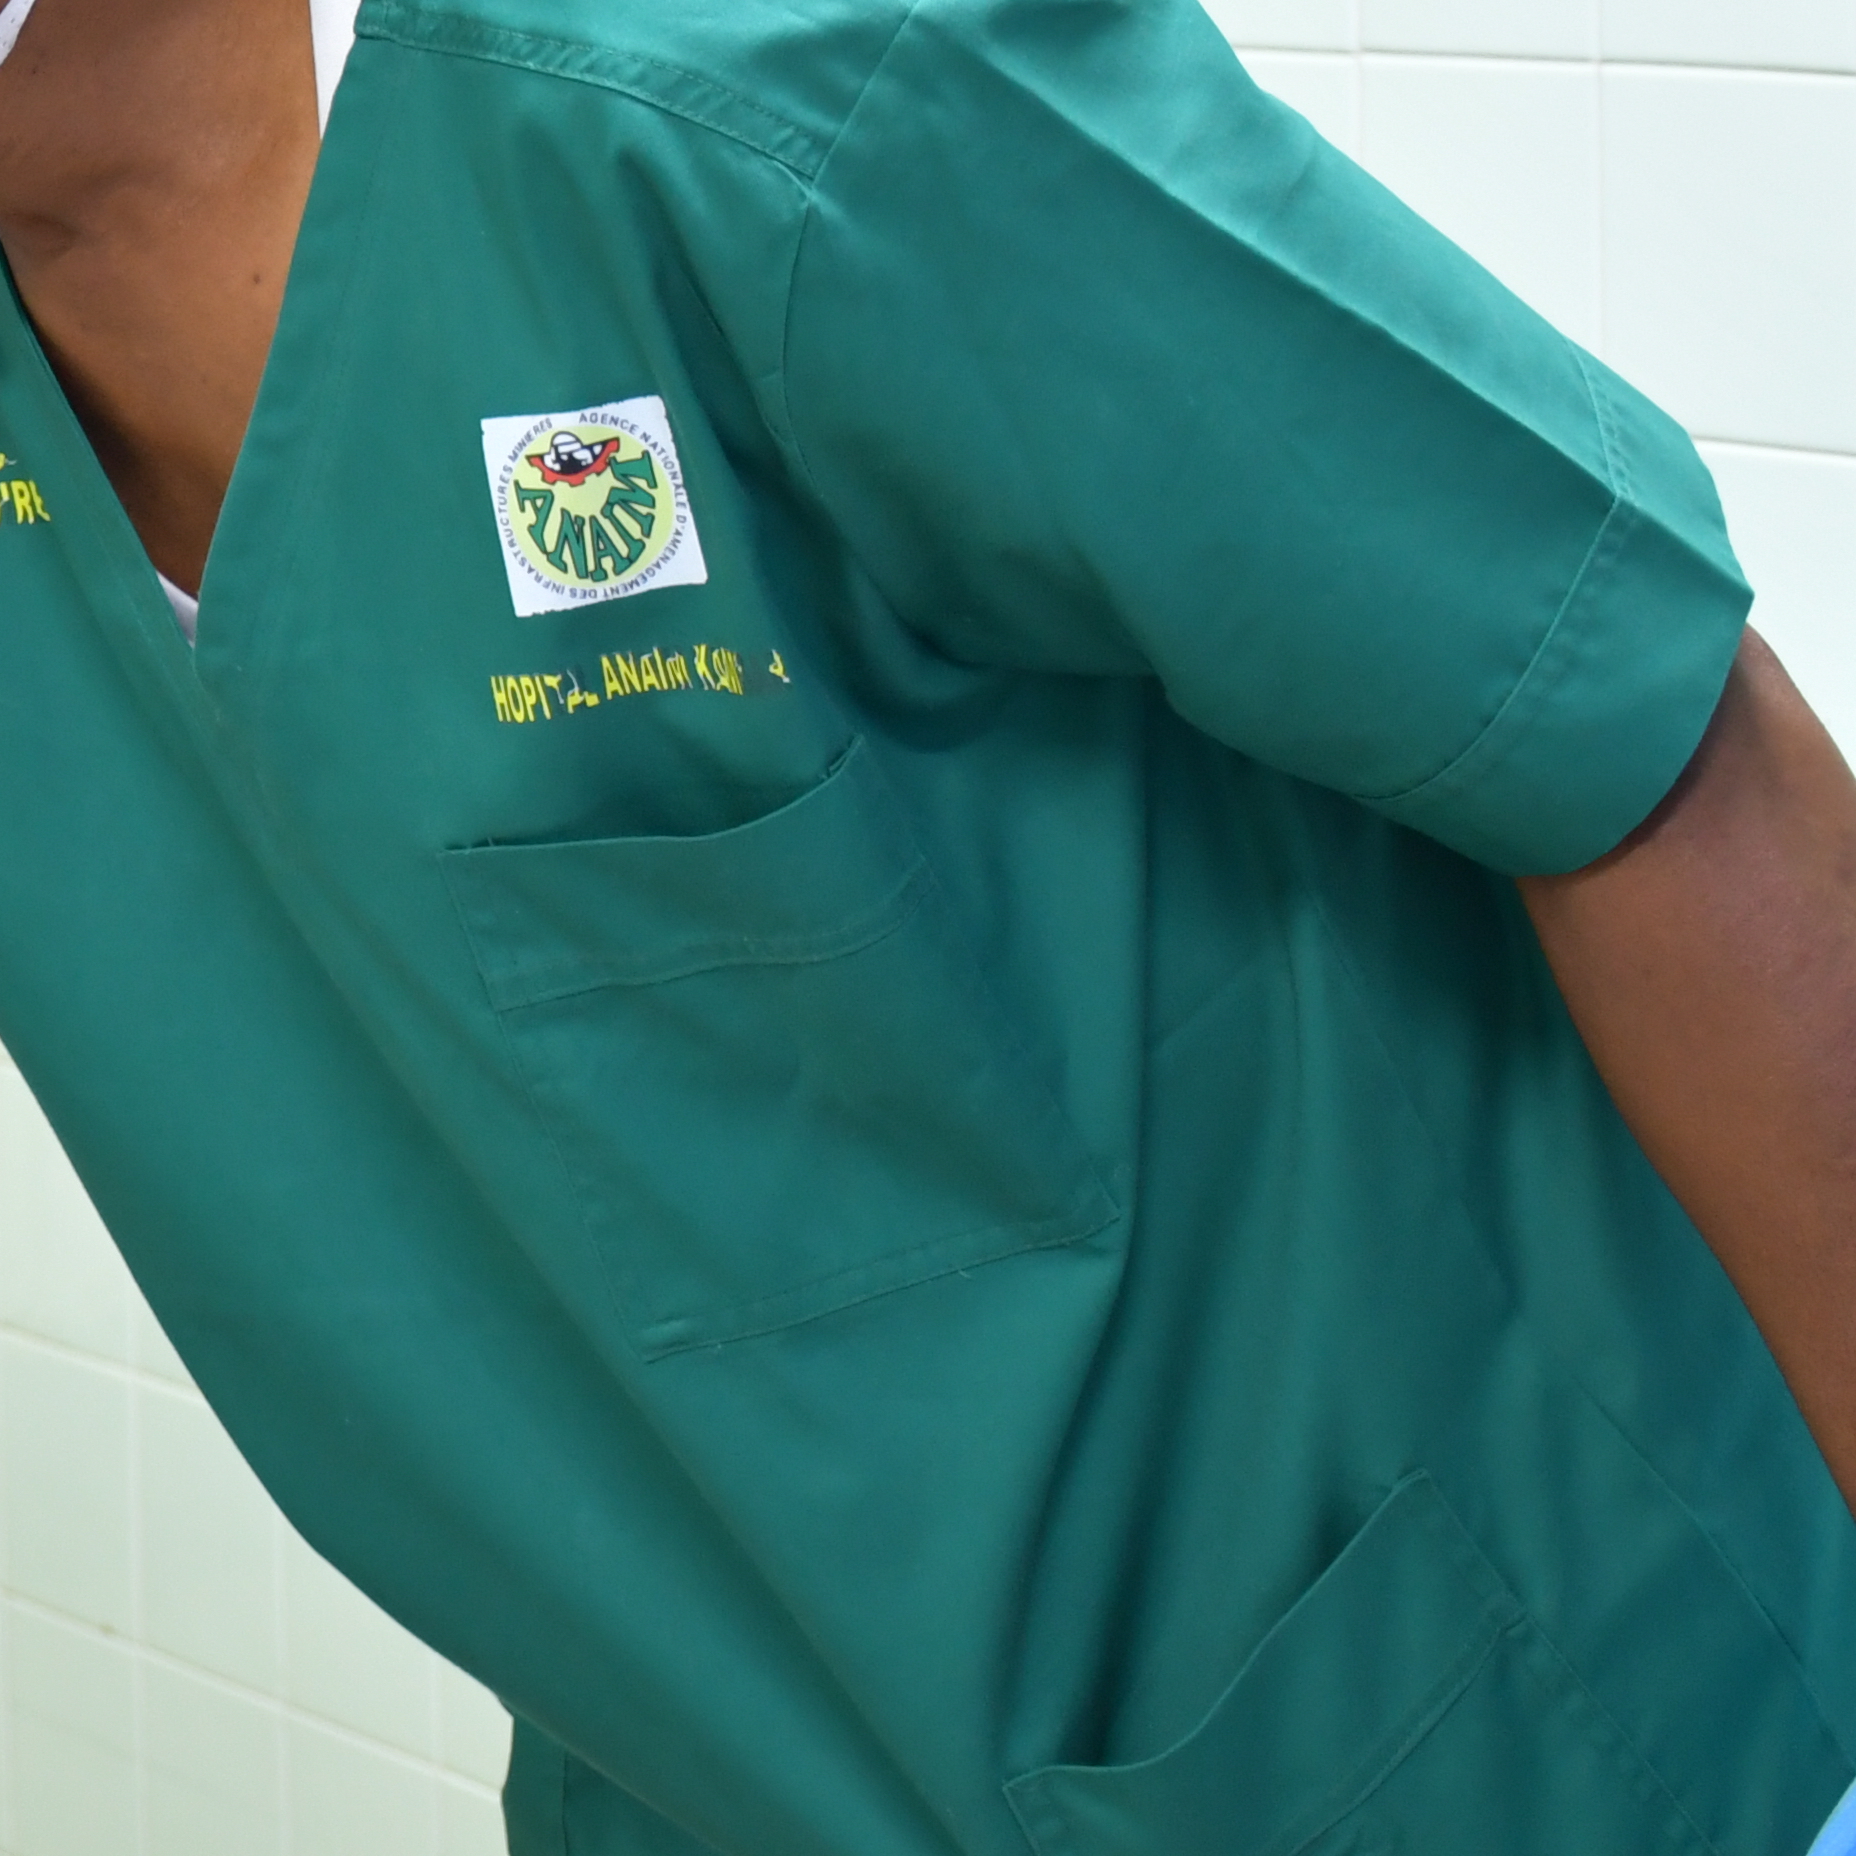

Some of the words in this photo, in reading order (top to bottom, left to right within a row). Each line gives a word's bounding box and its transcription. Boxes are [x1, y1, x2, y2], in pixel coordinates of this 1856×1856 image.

[578, 411, 638, 436] AGENCE
[639, 431, 688, 510] NATIONALE
[496, 465, 565, 596] INFRASTRUCTURES
[513, 448, 659, 583] ANAIM
[568, 586, 599, 600] DES
